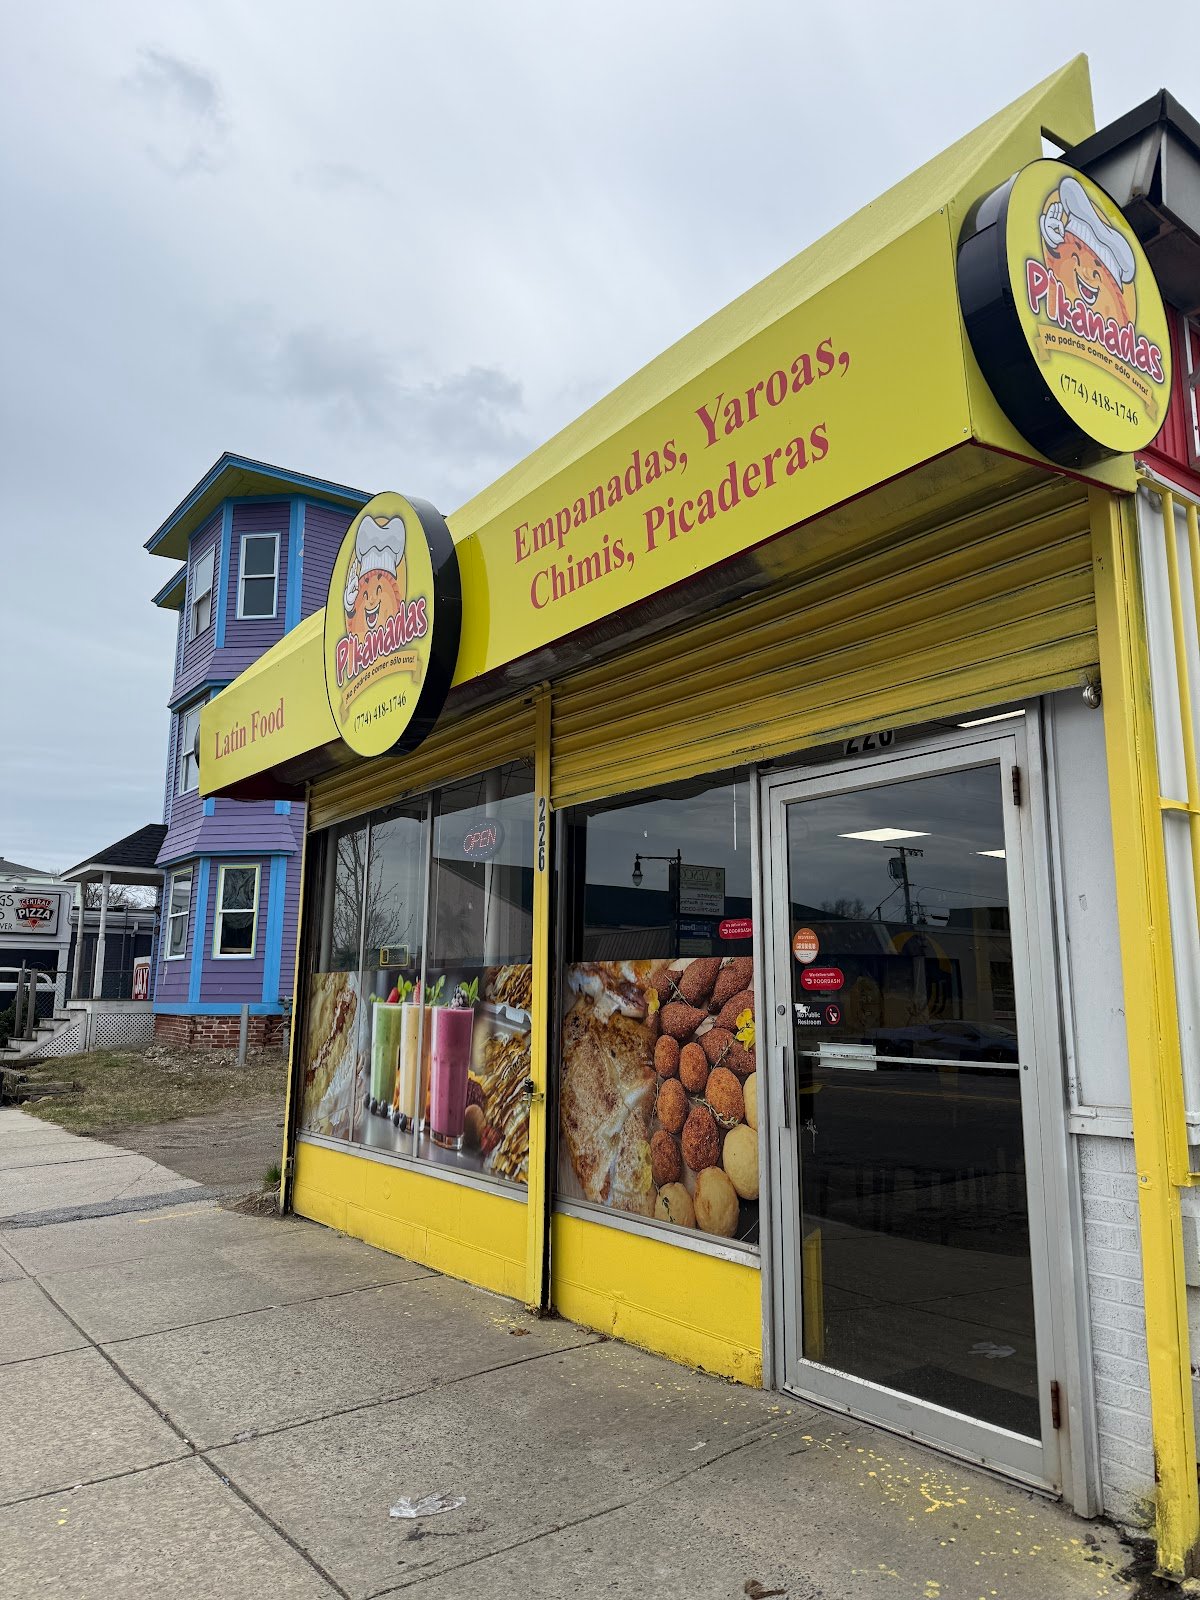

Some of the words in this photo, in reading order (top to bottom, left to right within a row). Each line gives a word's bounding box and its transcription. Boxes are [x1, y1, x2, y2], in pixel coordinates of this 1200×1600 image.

[1058, 336, 1085, 351] podrás
[1087, 347, 1113, 365] comer
[1114, 363, 1130, 379] sólo
[1060, 373, 1089, 403] (774)
[1091, 390, 1139, 426] 418-1746
[512, 438, 688, 565] Empanadas,
[694, 337, 850, 450] Yaroas,
[529, 534, 635, 610] Chimis,
[642, 422, 830, 554] Picaderas
[371, 661, 389, 676] comer
[214, 722, 247, 760] Latin
[250, 697, 284, 743] Food
[354, 710, 372, 733] (774)
[373, 690, 407, 719] 418-1746
[464, 827, 497, 852] OPEN
[538, 797, 546, 872] 226
[18, 908, 50, 919] PIZZA
[22, 898, 49, 906] CENTRAL
[797, 1018, 822, 1026] Restroom
